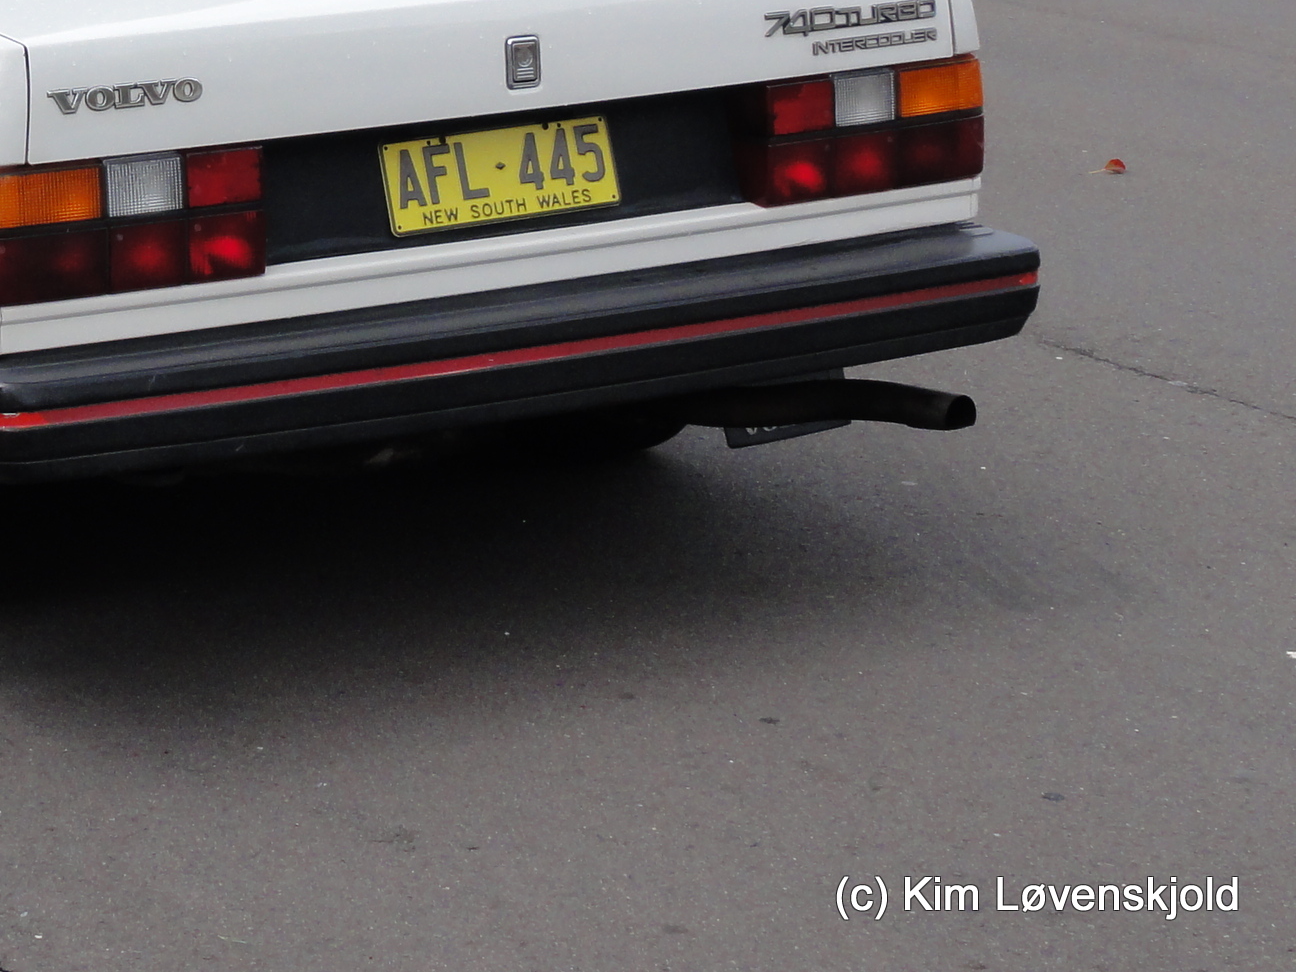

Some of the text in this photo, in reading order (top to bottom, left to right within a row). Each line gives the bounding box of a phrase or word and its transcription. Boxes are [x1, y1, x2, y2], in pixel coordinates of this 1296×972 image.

[812, 27, 937, 56] INTERCOOLER
[47, 77, 204, 115] VOLVO
[422, 188, 593, 226] NEW SOUTH WALES
